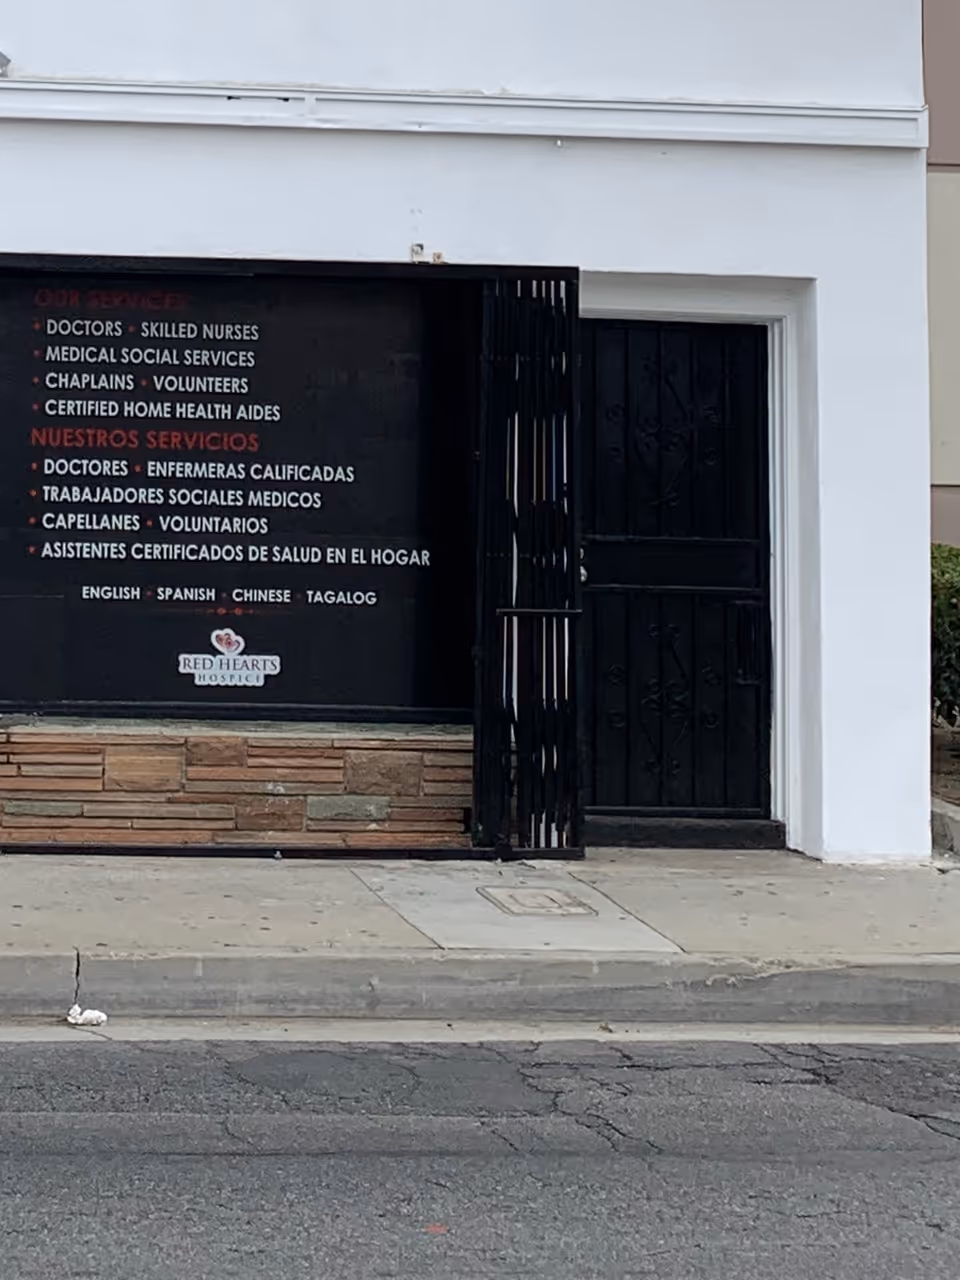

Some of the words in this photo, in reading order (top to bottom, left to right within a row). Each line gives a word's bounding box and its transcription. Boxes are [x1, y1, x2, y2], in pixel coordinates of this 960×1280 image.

[34, 288, 79, 308] OUR
[46, 319, 123, 337] DOCTORS
[140, 321, 198, 339] SKILLED
[202, 323, 259, 341] NURSES
[45, 347, 117, 364] MEDICAL
[121, 348, 180, 366] SOCIAL
[183, 349, 255, 367] SERVICES
[45, 373, 134, 391] CHAPLAINS
[153, 375, 249, 394] VOLUNTEERS
[44, 399, 119, 417] CERTIFIED
[124, 401, 171, 419] HOME
[175, 402, 232, 420] HEALTH
[236, 404, 281, 422] AIDES
[30, 428, 139, 449] NUESTROS
[146, 431, 260, 452] SERVICIOS
[43, 459, 129, 477] DOCTORES
[147, 461, 246, 480] ENFERMERAS
[250, 464, 355, 483] CALIFICADAS
[42, 486, 164, 504] TRABAJADORES
[168, 488, 244, 507] SOCIALES
[248, 490, 322, 509] MEDICOS
[42, 513, 140, 531] CAPELLANES
[159, 515, 269, 534] VOLUNTARIOS
[41, 542, 127, 560] ASISTENTES
[131, 543, 243, 562] CERTIFICADOS
[248, 545, 268, 562] DE
[272, 546, 322, 564] SALUD
[326, 547, 347, 564] EN
[351, 548, 367, 565] EL
[371, 548, 431, 567] HOGAR
[81, 585, 140, 600] ENGLISH
[156, 587, 216, 602] SPANISH
[232, 588, 291, 604] CHINESE
[305, 590, 378, 606] TAGALOG
[182, 657, 214, 671] RED
[219, 658, 278, 672] HEARTS
